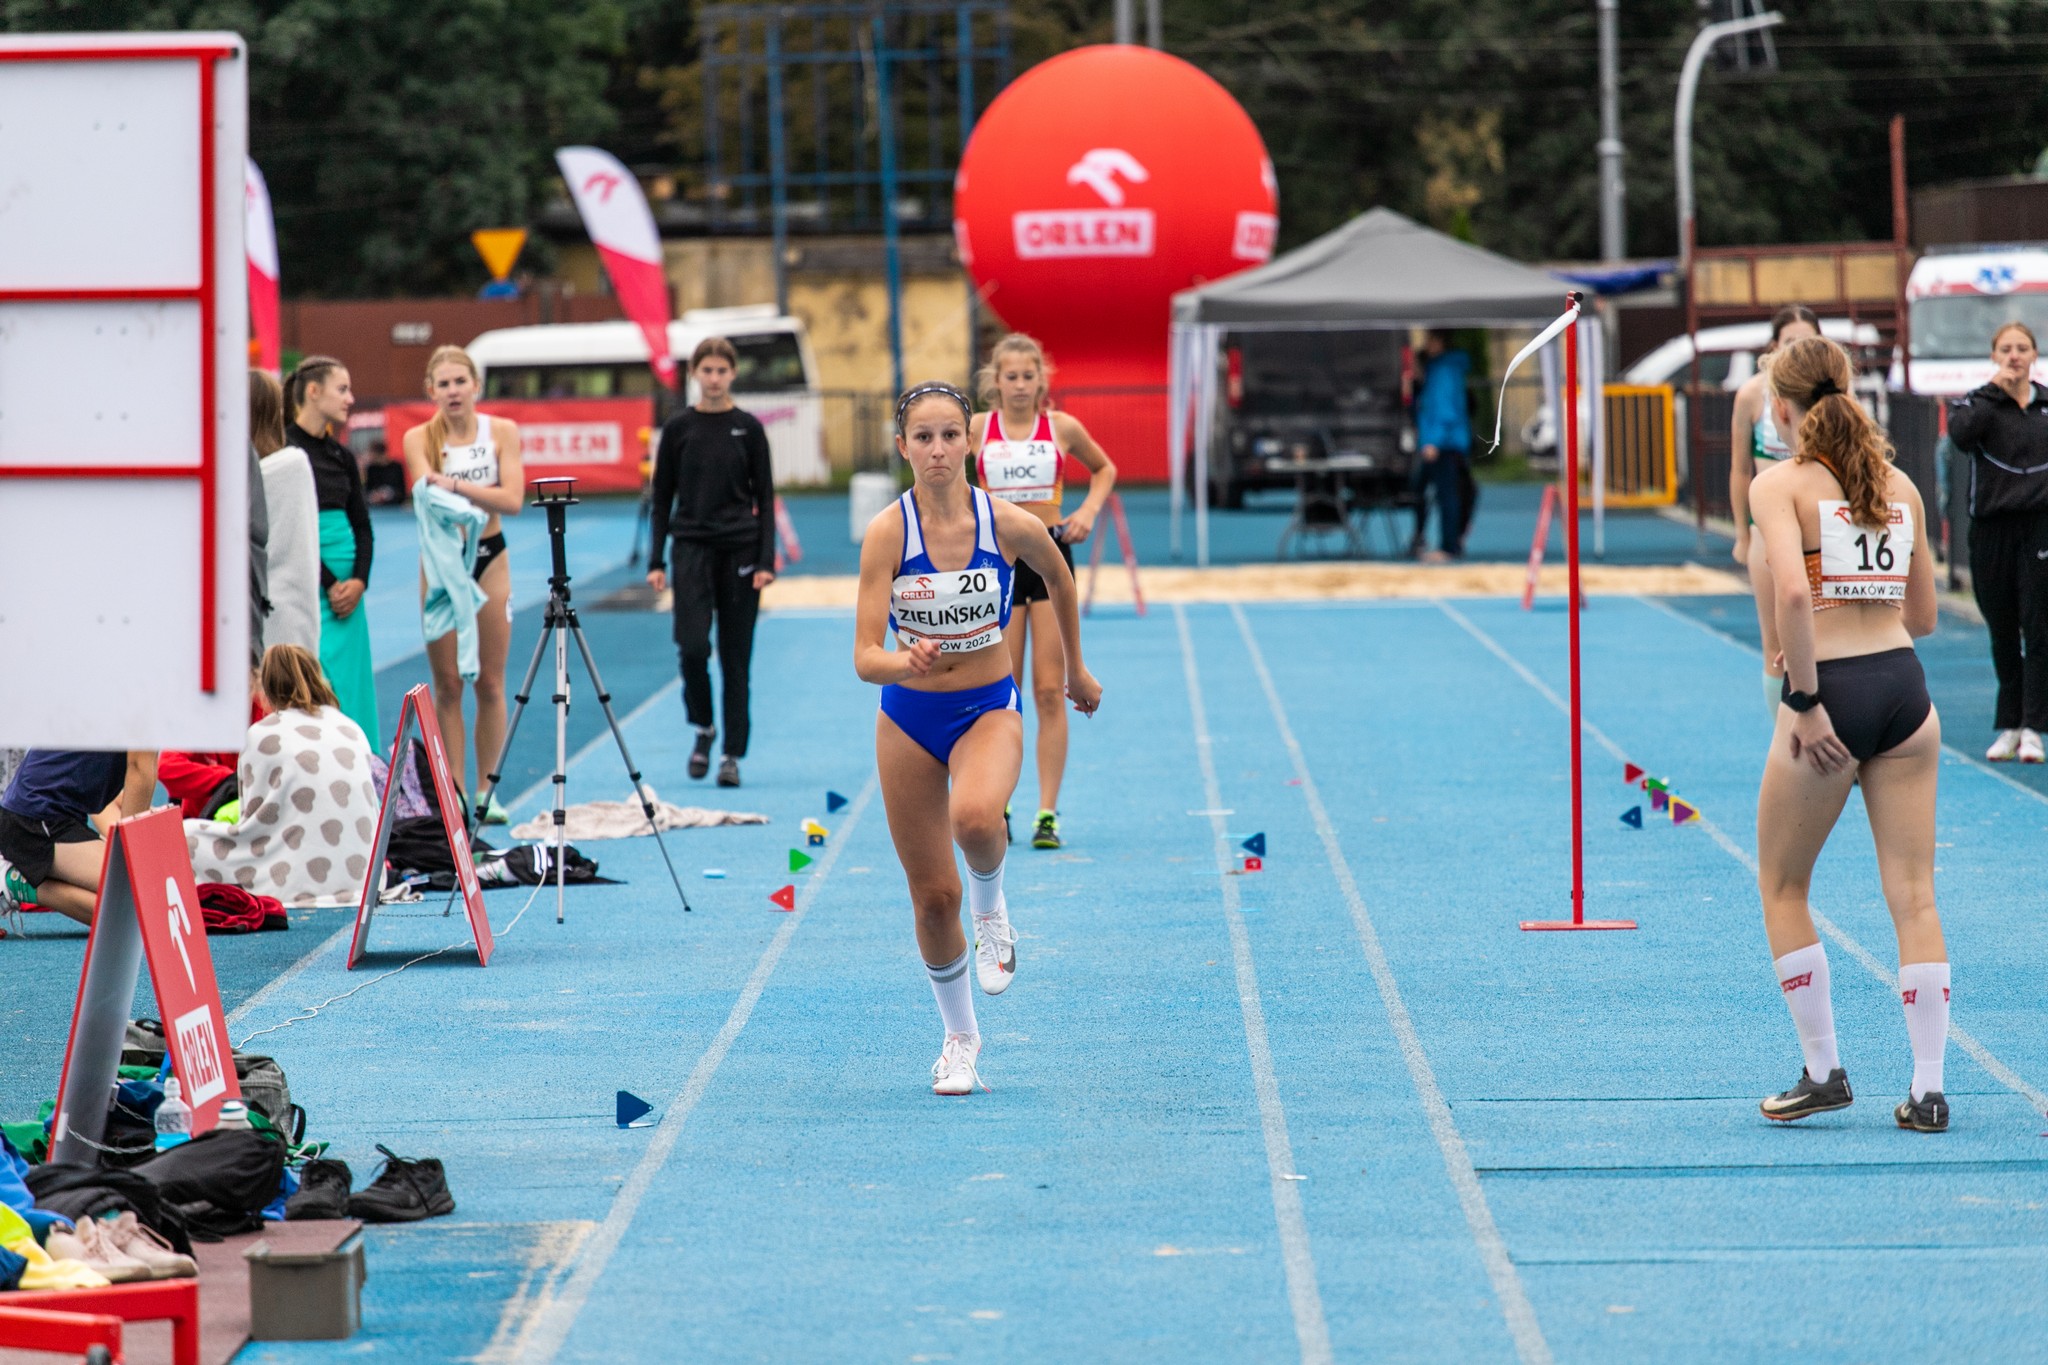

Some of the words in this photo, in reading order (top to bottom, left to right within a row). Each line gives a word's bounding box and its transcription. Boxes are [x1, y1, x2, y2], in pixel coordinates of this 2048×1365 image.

[1024, 222, 1142, 247] ORLEN
[468, 447, 487, 460] 39
[1027, 444, 1046, 456] 24
[446, 466, 489, 481] OKOT
[1003, 465, 1037, 480] HOC
[1854, 533, 1895, 572] 16
[958, 573, 987, 594] 20
[1834, 582, 1887, 597] KRAKÓW
[902, 591, 933, 599] ORLEN
[898, 602, 996, 626] ZIELIŃSKA
[965, 634, 991, 649] 2022
[181, 1020, 220, 1092] ORLEN
